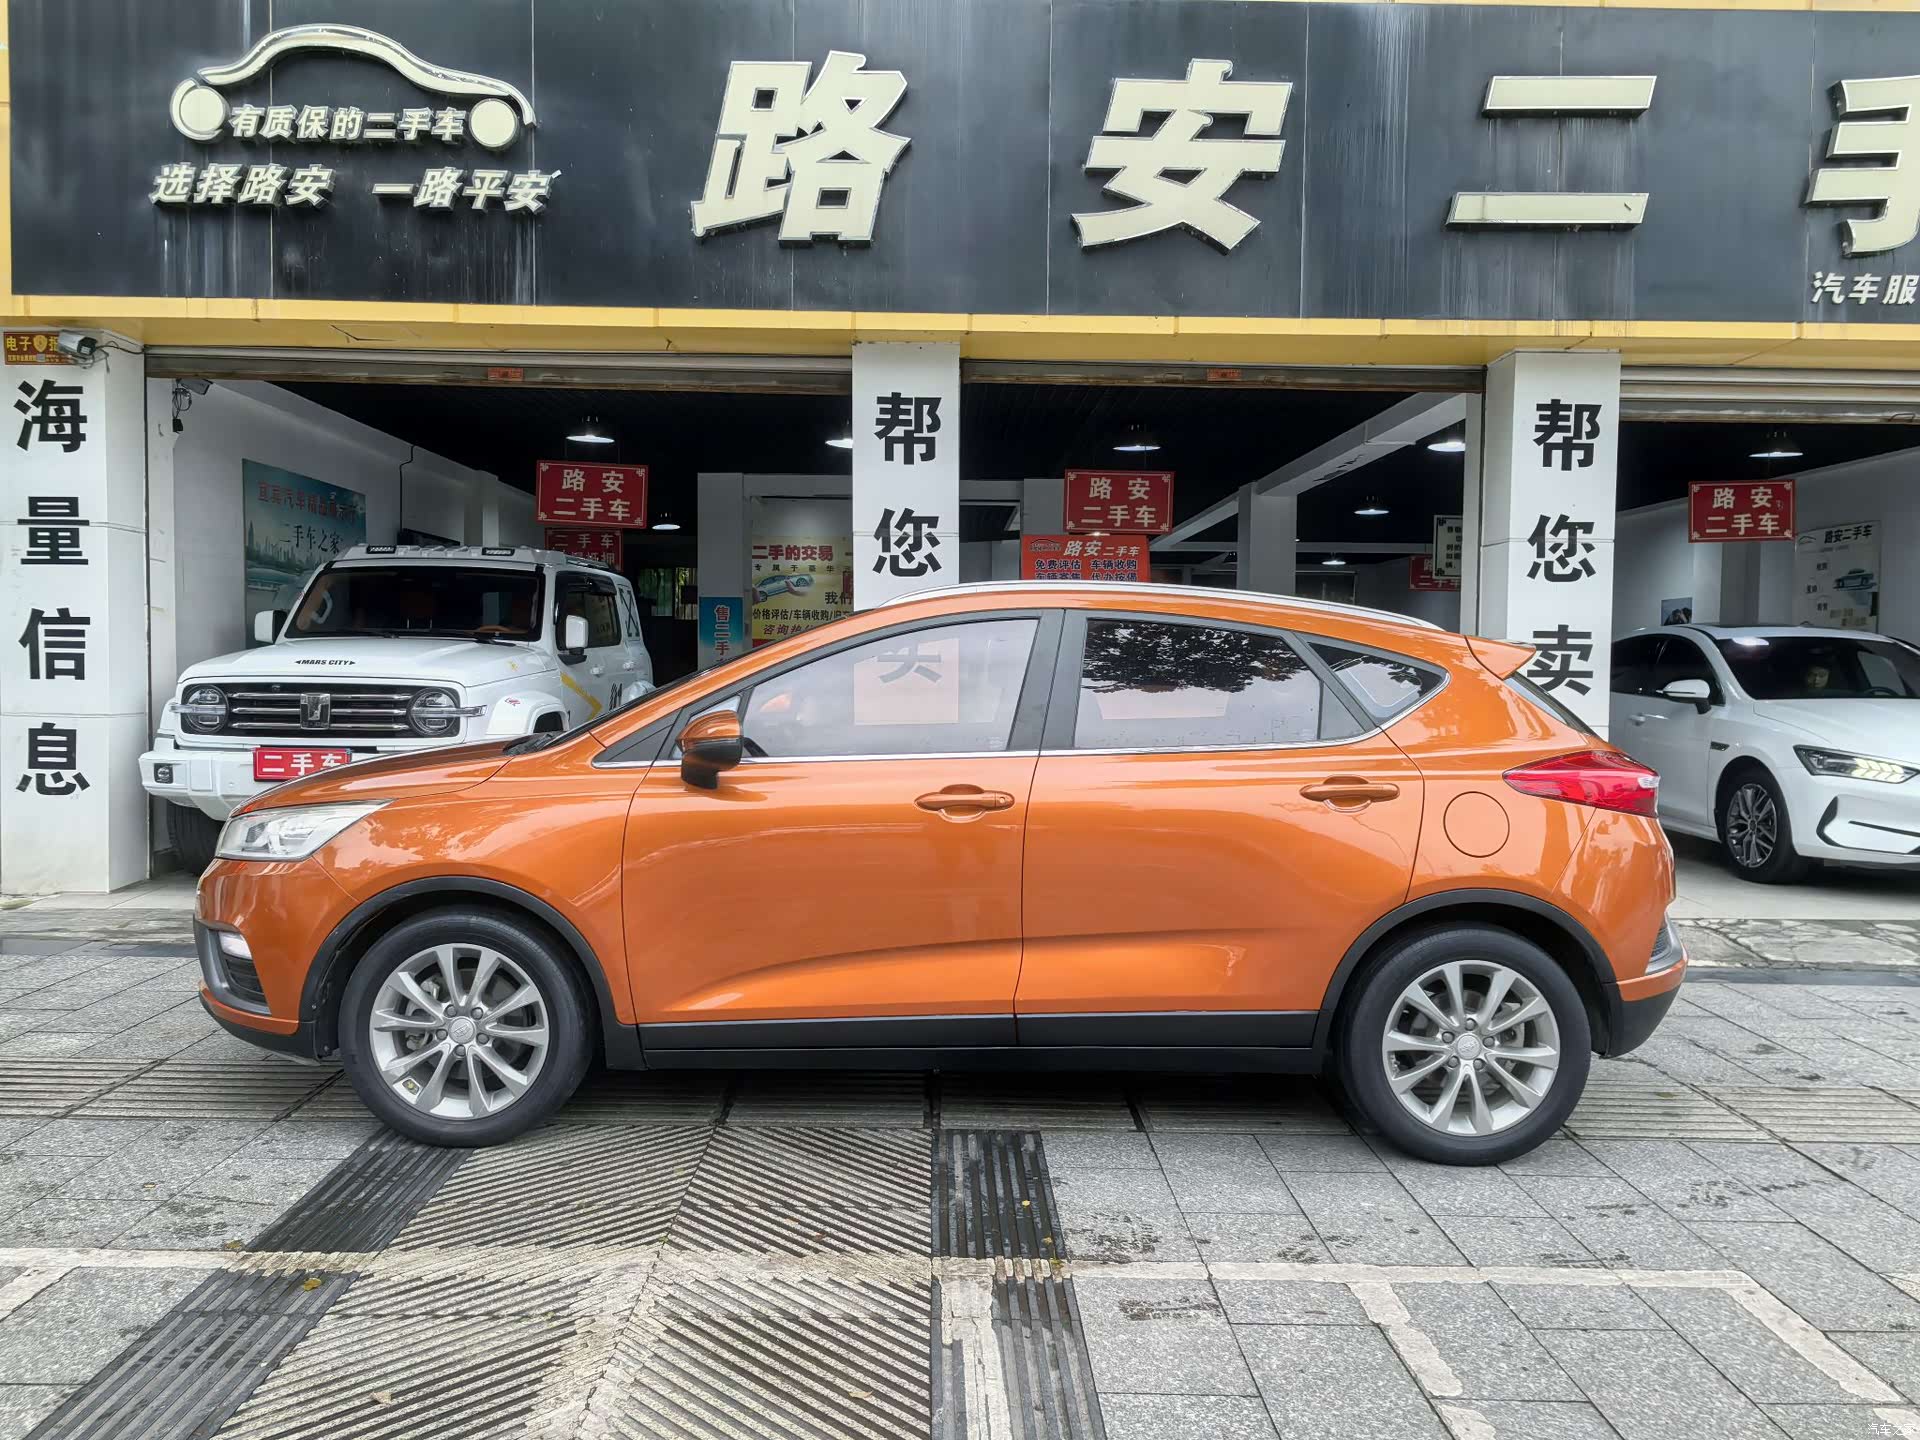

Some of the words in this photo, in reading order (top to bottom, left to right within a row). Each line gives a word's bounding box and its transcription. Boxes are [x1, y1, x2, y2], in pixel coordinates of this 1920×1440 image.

[231, 105, 468, 141] 有质保的二手车
[152, 162, 335, 207] 选择路安
[371, 166, 553, 212] 一路平安
[1811, 271, 1918, 306] 汽车服
[6, 335, 32, 351] 电子
[561, 468, 625, 494] 路安
[1089, 477, 1150, 500] 路安
[553, 497, 631, 521] 二手车
[1712, 486, 1773, 509] 路安
[1081, 505, 1157, 528] 二手车
[1705, 512, 1779, 536] 二手车
[555, 533, 614, 549] 二手车
[1063, 540, 1140, 557] 路安二手车
[1527, 399, 1603, 697] 帮您卖
[752, 545, 833, 562] 二手的交易
[1091, 559, 1137, 570] 车辆收购
[14, 378, 91, 796] 海量信息
[714, 604, 731, 661] 售二手
